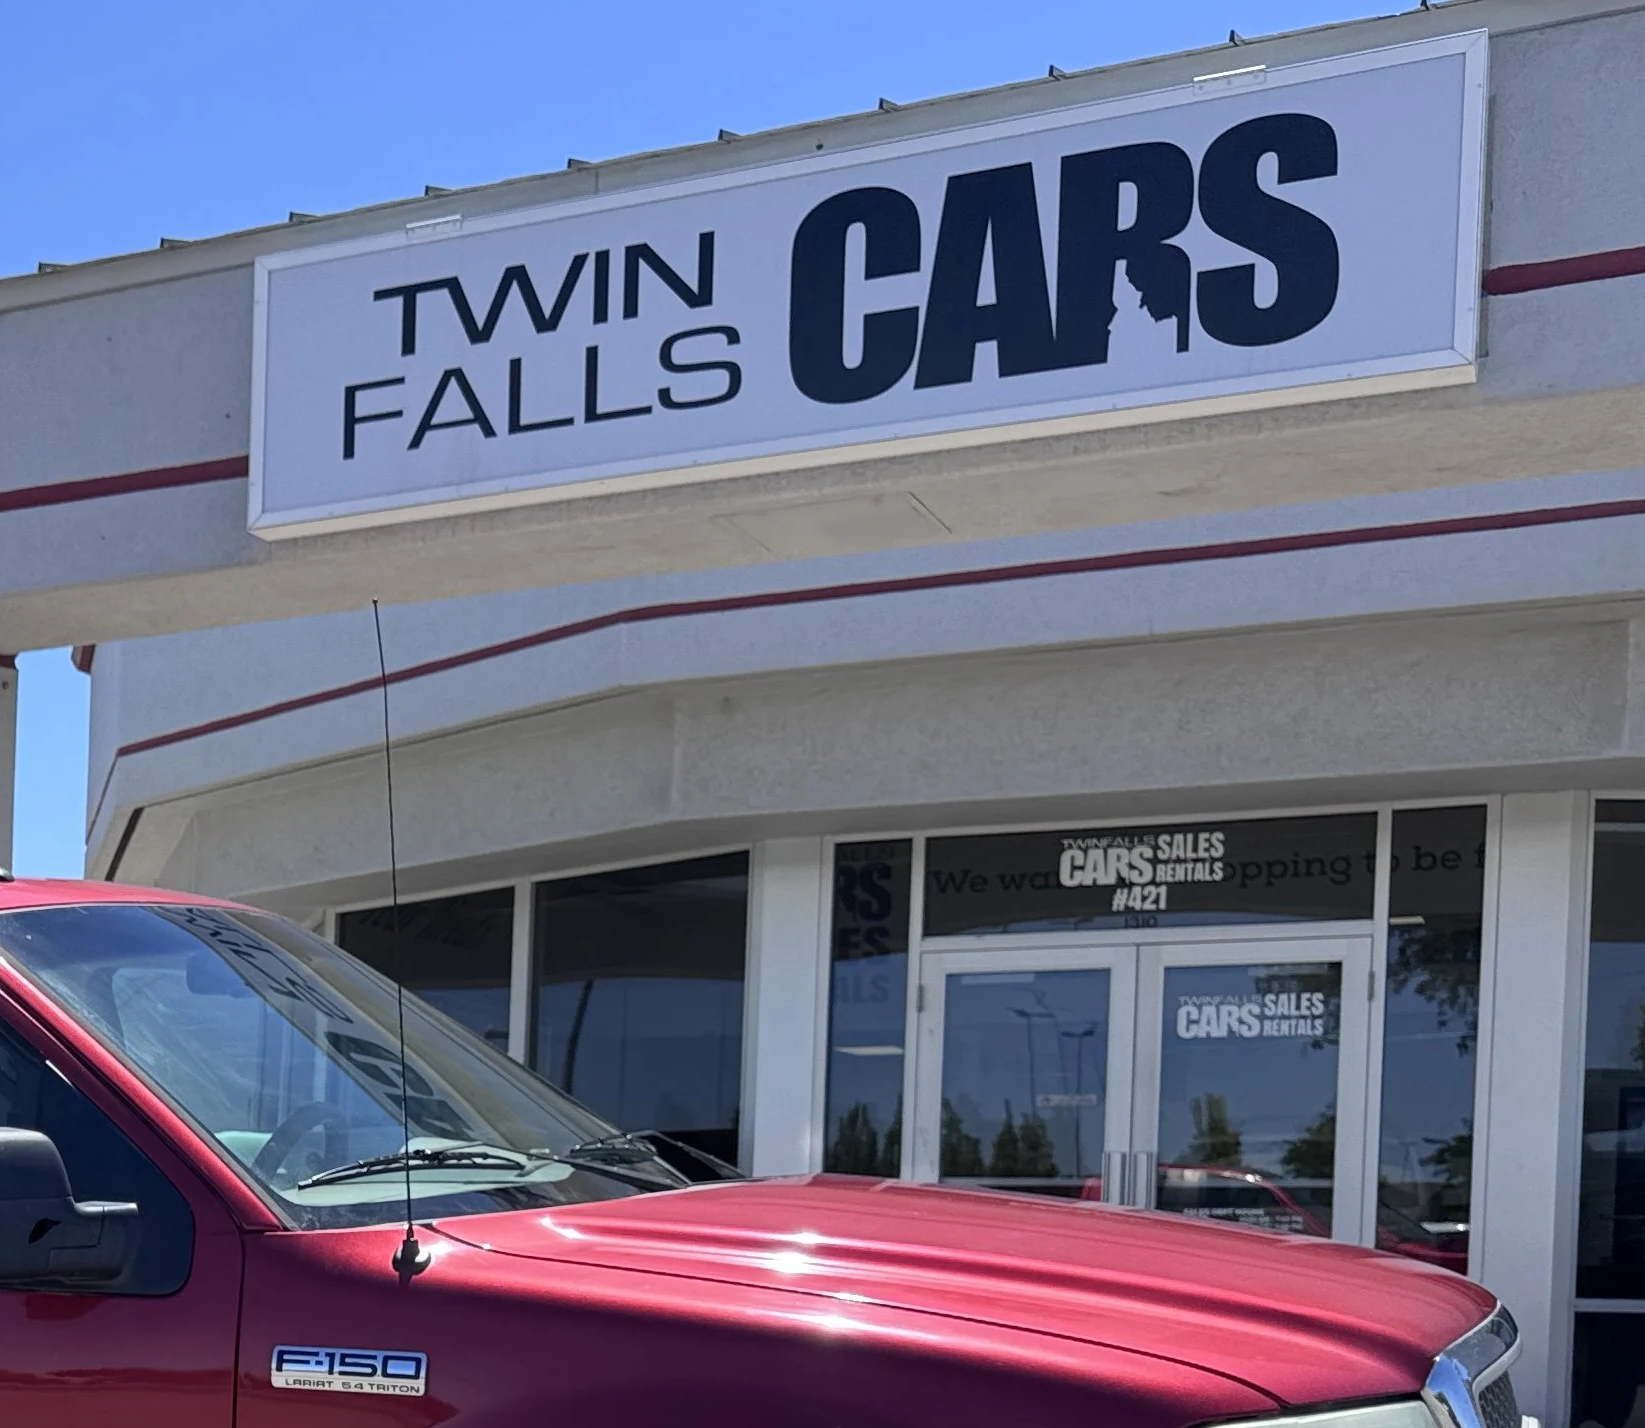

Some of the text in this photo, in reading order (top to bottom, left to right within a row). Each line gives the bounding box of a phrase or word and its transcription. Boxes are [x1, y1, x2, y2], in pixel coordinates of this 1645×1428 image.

[789, 111, 1340, 405] CARS
[373, 231, 715, 357] TWIN
[343, 325, 742, 461] FALLS
[1157, 832, 1224, 859] SALES
[931, 867, 988, 895] We
[1411, 844, 1463, 872] be
[1059, 846, 1155, 887] CARS
[1156, 861, 1224, 883] RENTALS
[1111, 885, 1167, 911] #421
[1264, 992, 1324, 1016] SALES
[1177, 1004, 1261, 1038] CARS
[1263, 1017, 1324, 1037] RENTALS
[276, 1349, 422, 1380] F-150
[285, 1378, 335, 1390] LARIAT
[368, 1382, 421, 1395] TRITON
